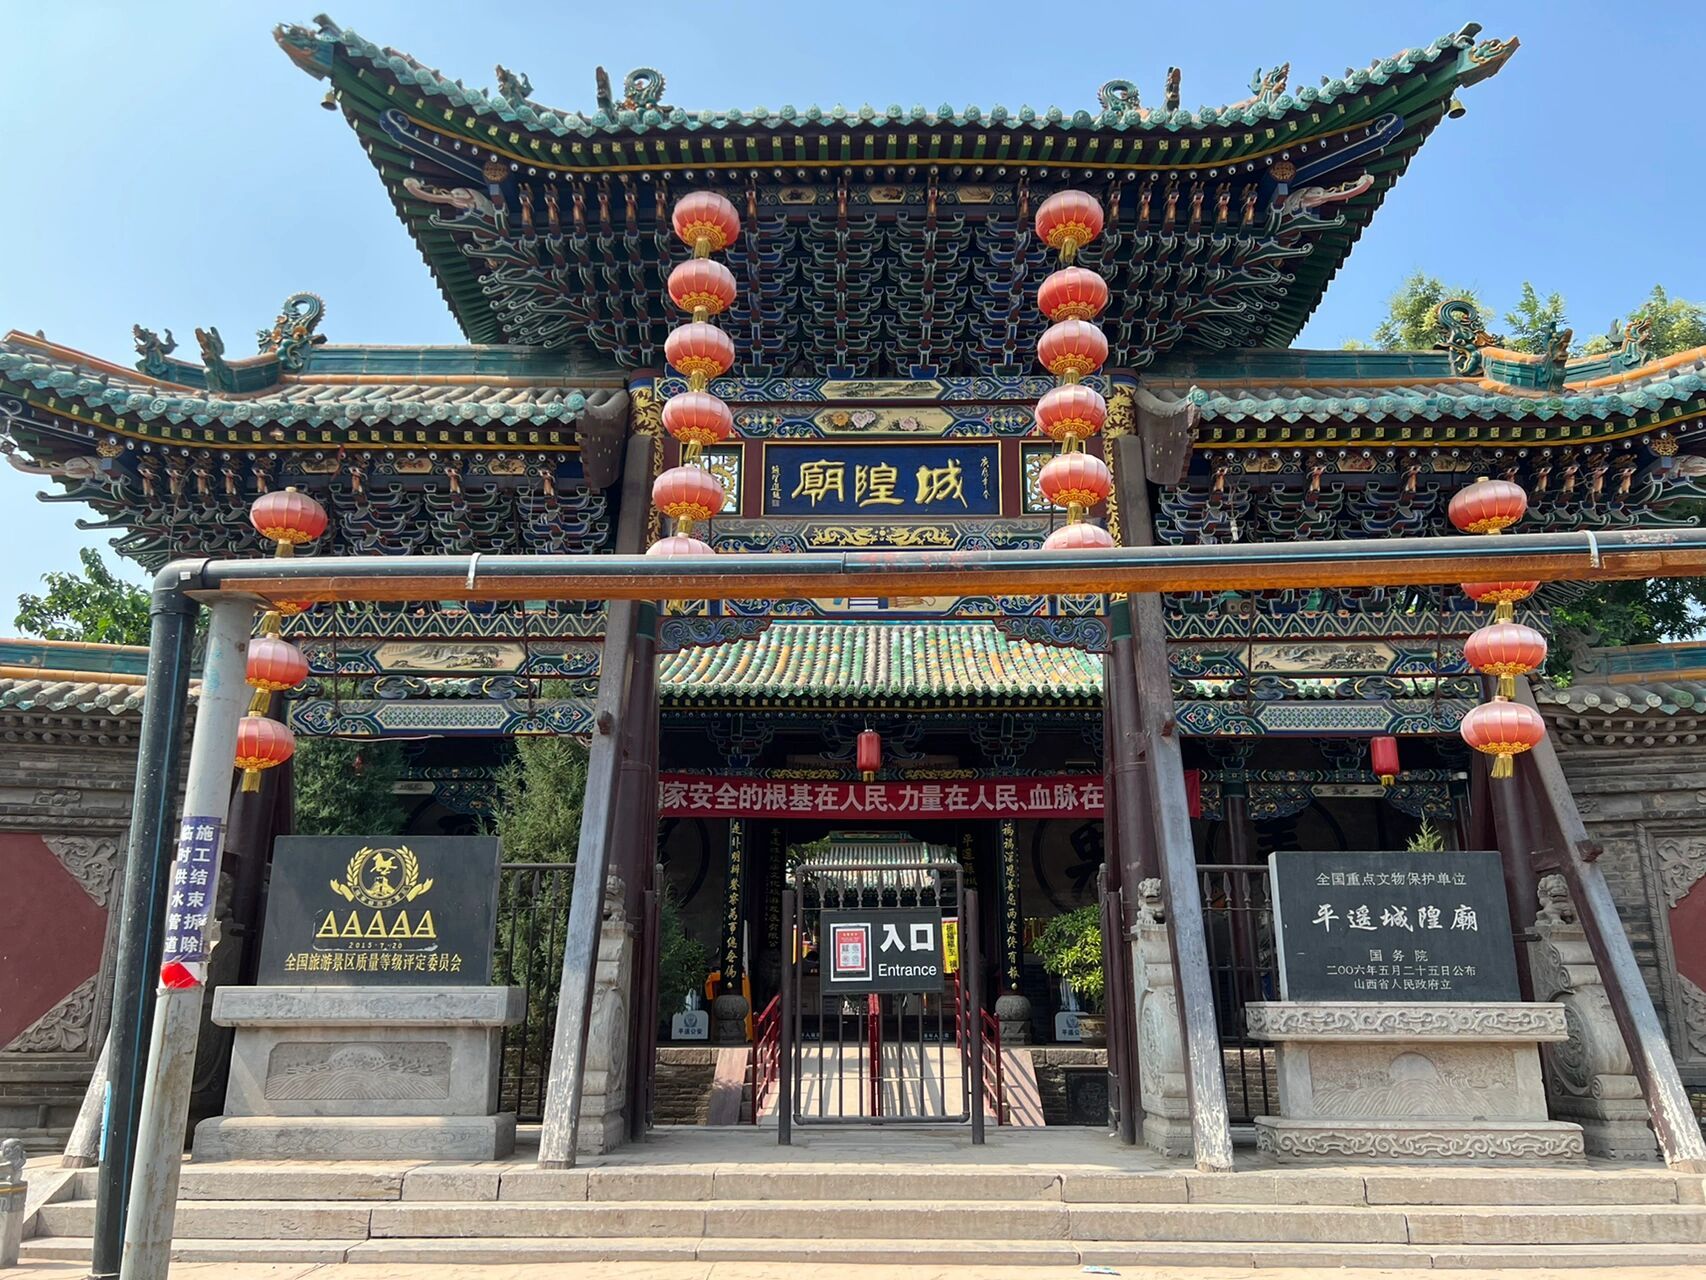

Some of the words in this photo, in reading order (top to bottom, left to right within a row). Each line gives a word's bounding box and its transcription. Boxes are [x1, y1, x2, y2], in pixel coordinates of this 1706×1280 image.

[658, 781, 1104, 812] 家安全的根基在人民、力量在人民、血脉在
[1316, 872, 1467, 887] 全国重点文物保护单位
[316, 910, 437, 938] AAAAA
[880, 923, 934, 952] 入口
[284, 952, 462, 973] 全国旅游景区质量等级评定委员会
[878, 963, 937, 976] Entrance
[1354, 979, 1452, 990] 山西省人民政府立
